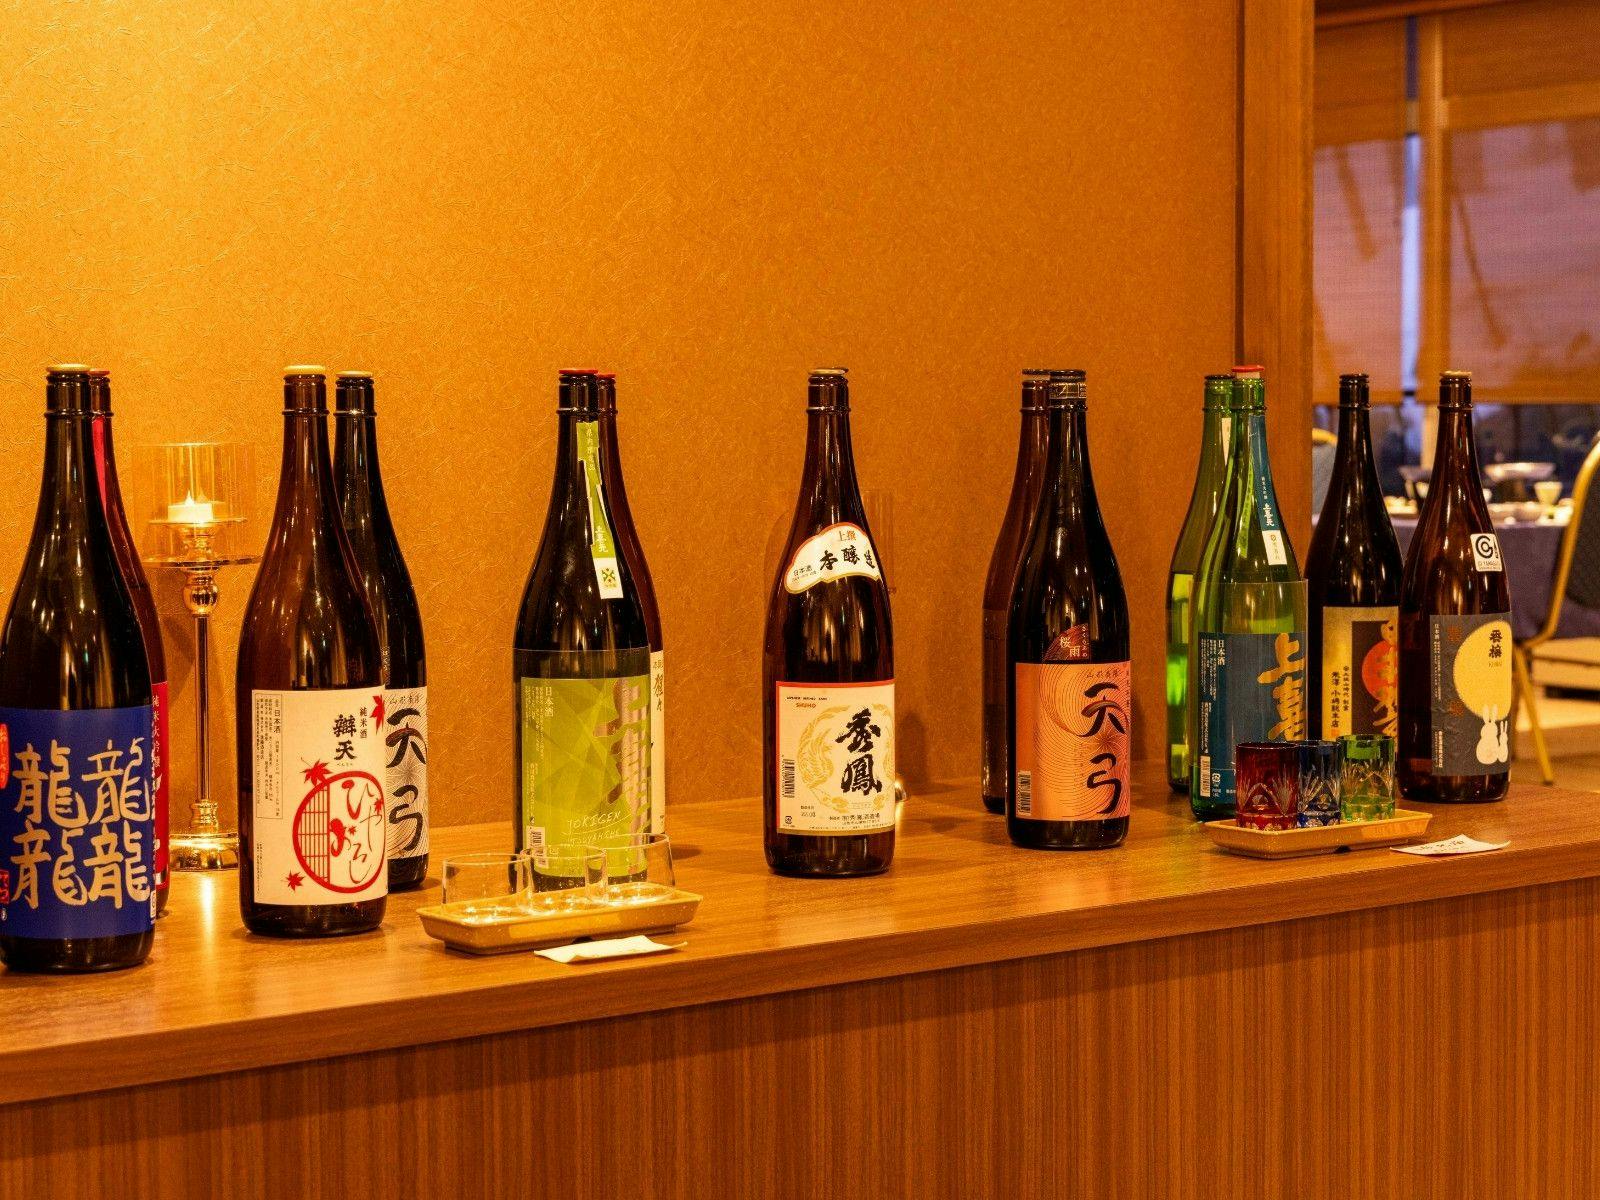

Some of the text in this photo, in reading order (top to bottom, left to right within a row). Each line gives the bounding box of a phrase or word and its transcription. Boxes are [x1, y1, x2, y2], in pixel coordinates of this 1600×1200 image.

[1263, 502, 1276, 527] 上喜元
[819, 545, 876, 571] 本醸造
[1217, 639, 1226, 666] 日本酒
[545, 686, 554, 717] 日本酒
[359, 706, 368, 738] 純米酒
[835, 706, 883, 796] 秀鳳
[386, 707, 428, 851] 天弓
